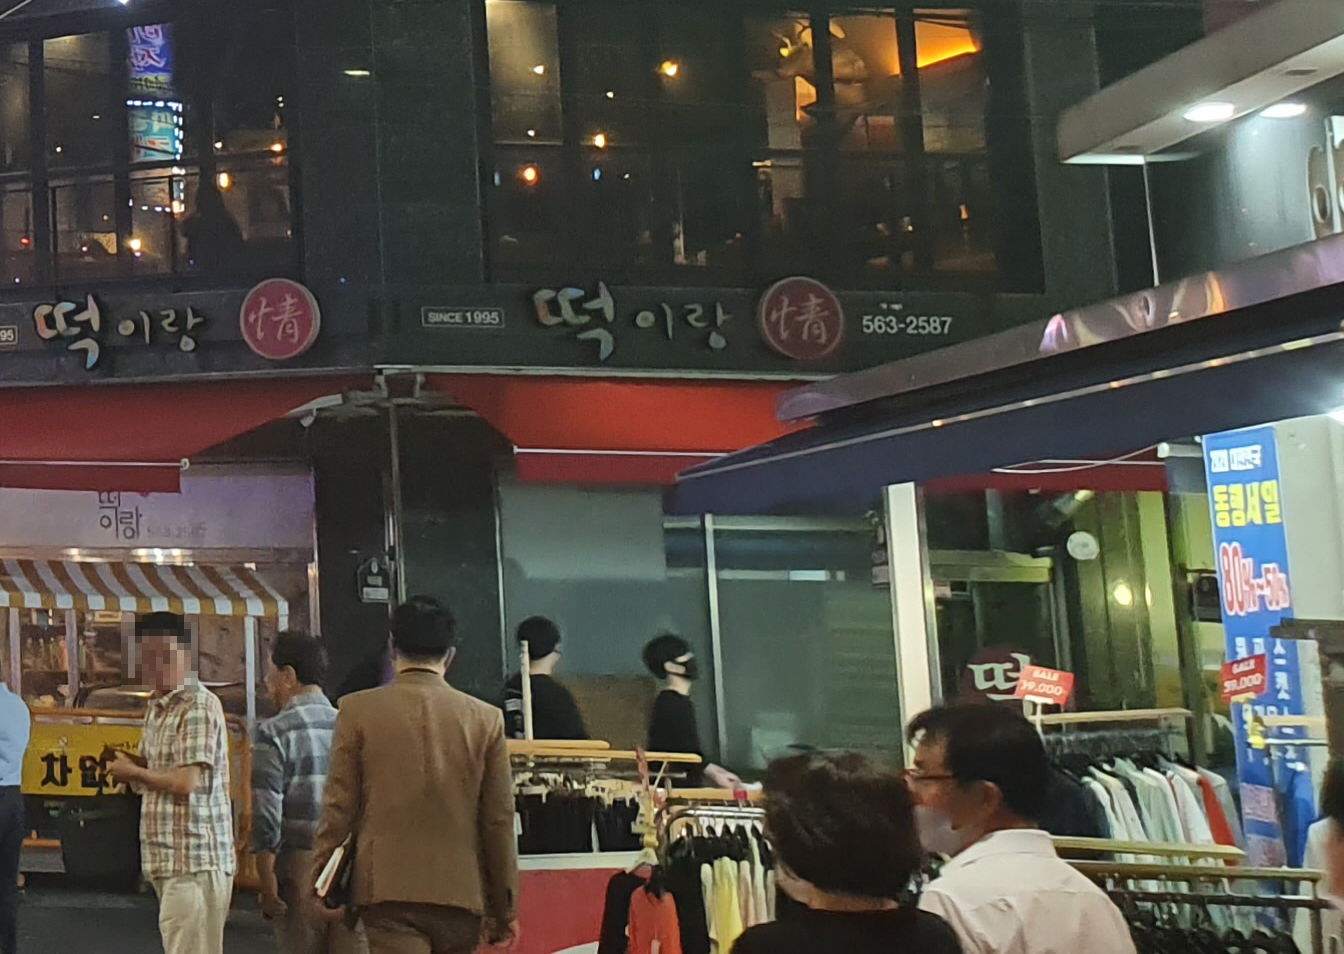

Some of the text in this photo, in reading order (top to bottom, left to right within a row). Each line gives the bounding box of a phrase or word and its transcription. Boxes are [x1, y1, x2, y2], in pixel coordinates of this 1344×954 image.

[33, 293, 205, 371] 떡이랑
[248, 294, 304, 344] 情
[427, 310, 499, 325] SINCE 1995
[532, 281, 734, 361] 떡이랑
[769, 294, 828, 345] 情
[862, 315, 953, 335] 563-2587
[1032, 669, 1059, 681] SALE
[40, 751, 72, 787] 차
